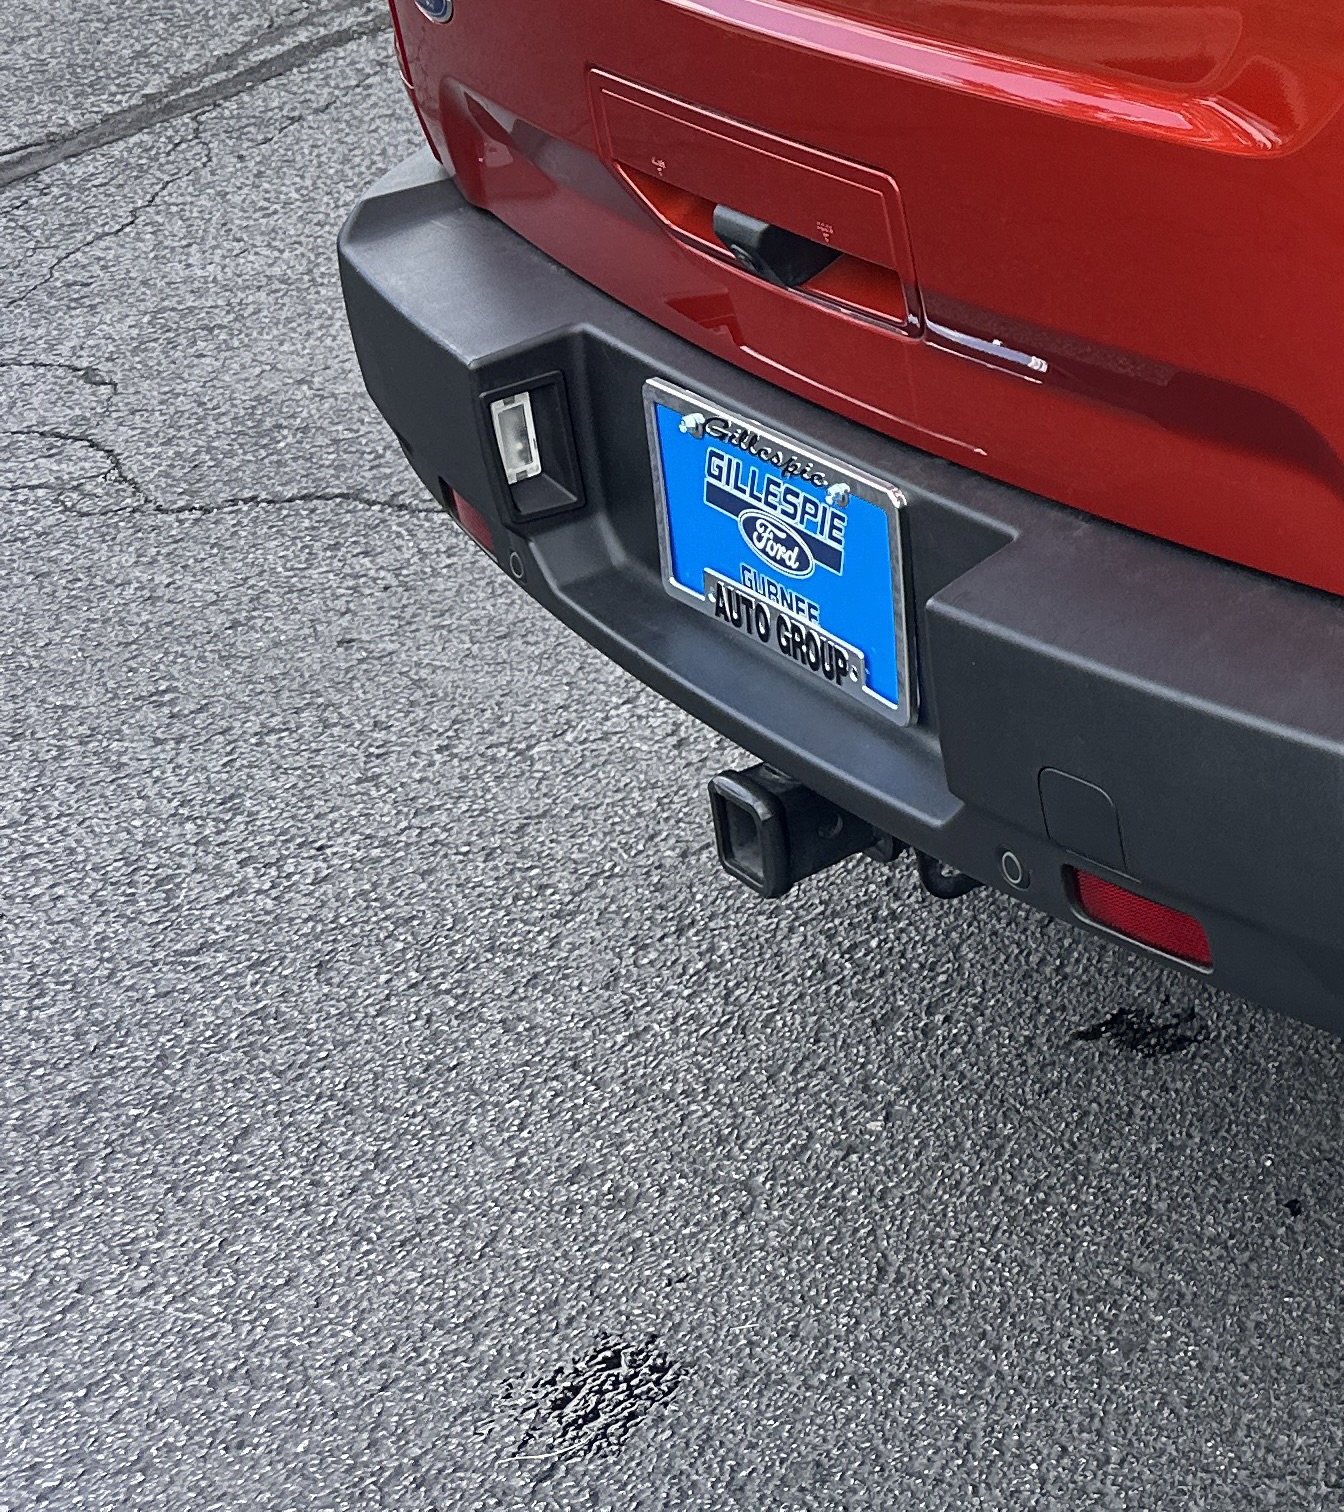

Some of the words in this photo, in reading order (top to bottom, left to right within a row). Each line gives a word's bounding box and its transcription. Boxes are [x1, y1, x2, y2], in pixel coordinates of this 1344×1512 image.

[704, 417, 828, 488] Gillespie
[705, 447, 848, 547] GILLESPIE
[753, 519, 799, 569] Ford
[715, 581, 771, 643] AUTO
[776, 614, 848, 685] GROUP
